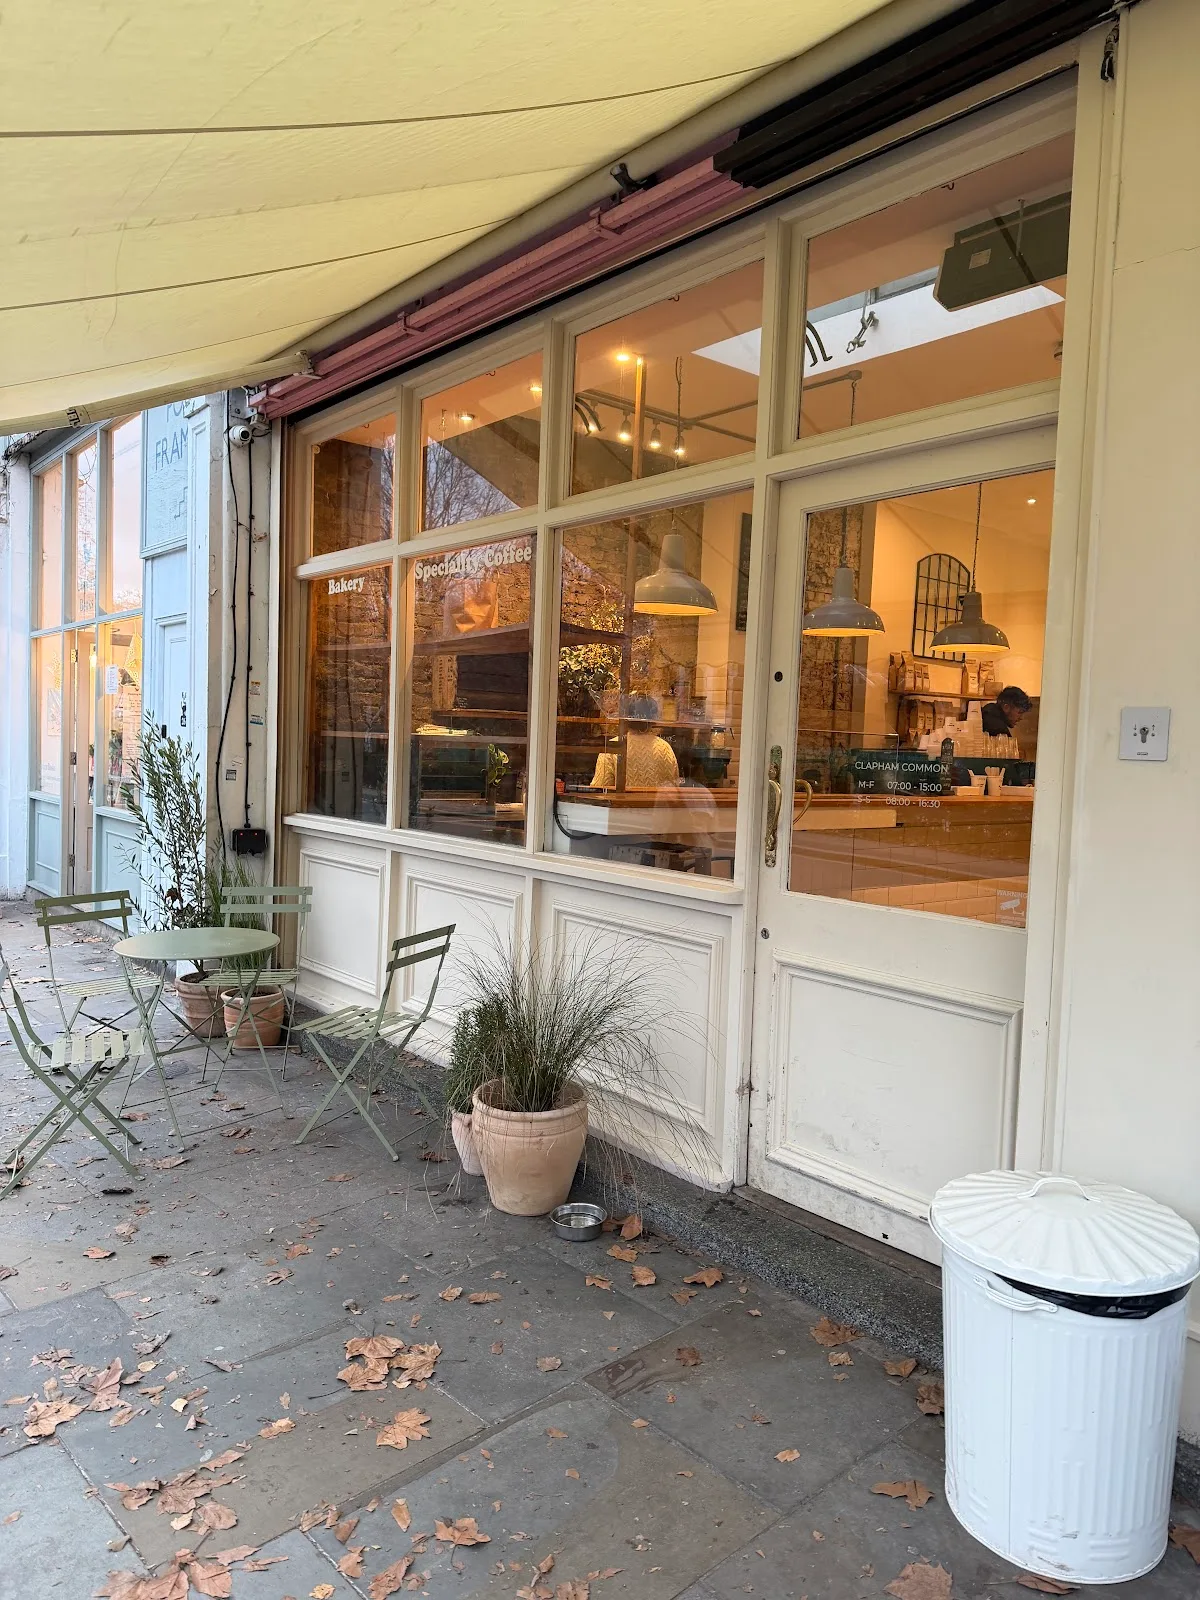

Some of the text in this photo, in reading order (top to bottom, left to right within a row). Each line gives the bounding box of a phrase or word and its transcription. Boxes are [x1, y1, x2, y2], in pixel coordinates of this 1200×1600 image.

[484, 544, 532, 568] Coffee
[328, 576, 365, 595] Bakery
[855, 761, 949, 774] CLAPHAM COMMON
[858, 780, 875, 789] M-F
[887, 781, 912, 790] 07:00
[919, 782, 942, 792] 15:00
[857, 795, 871, 804] S-S
[885, 796, 911, 806] 08:00
[918, 799, 941, 808] 16:30
